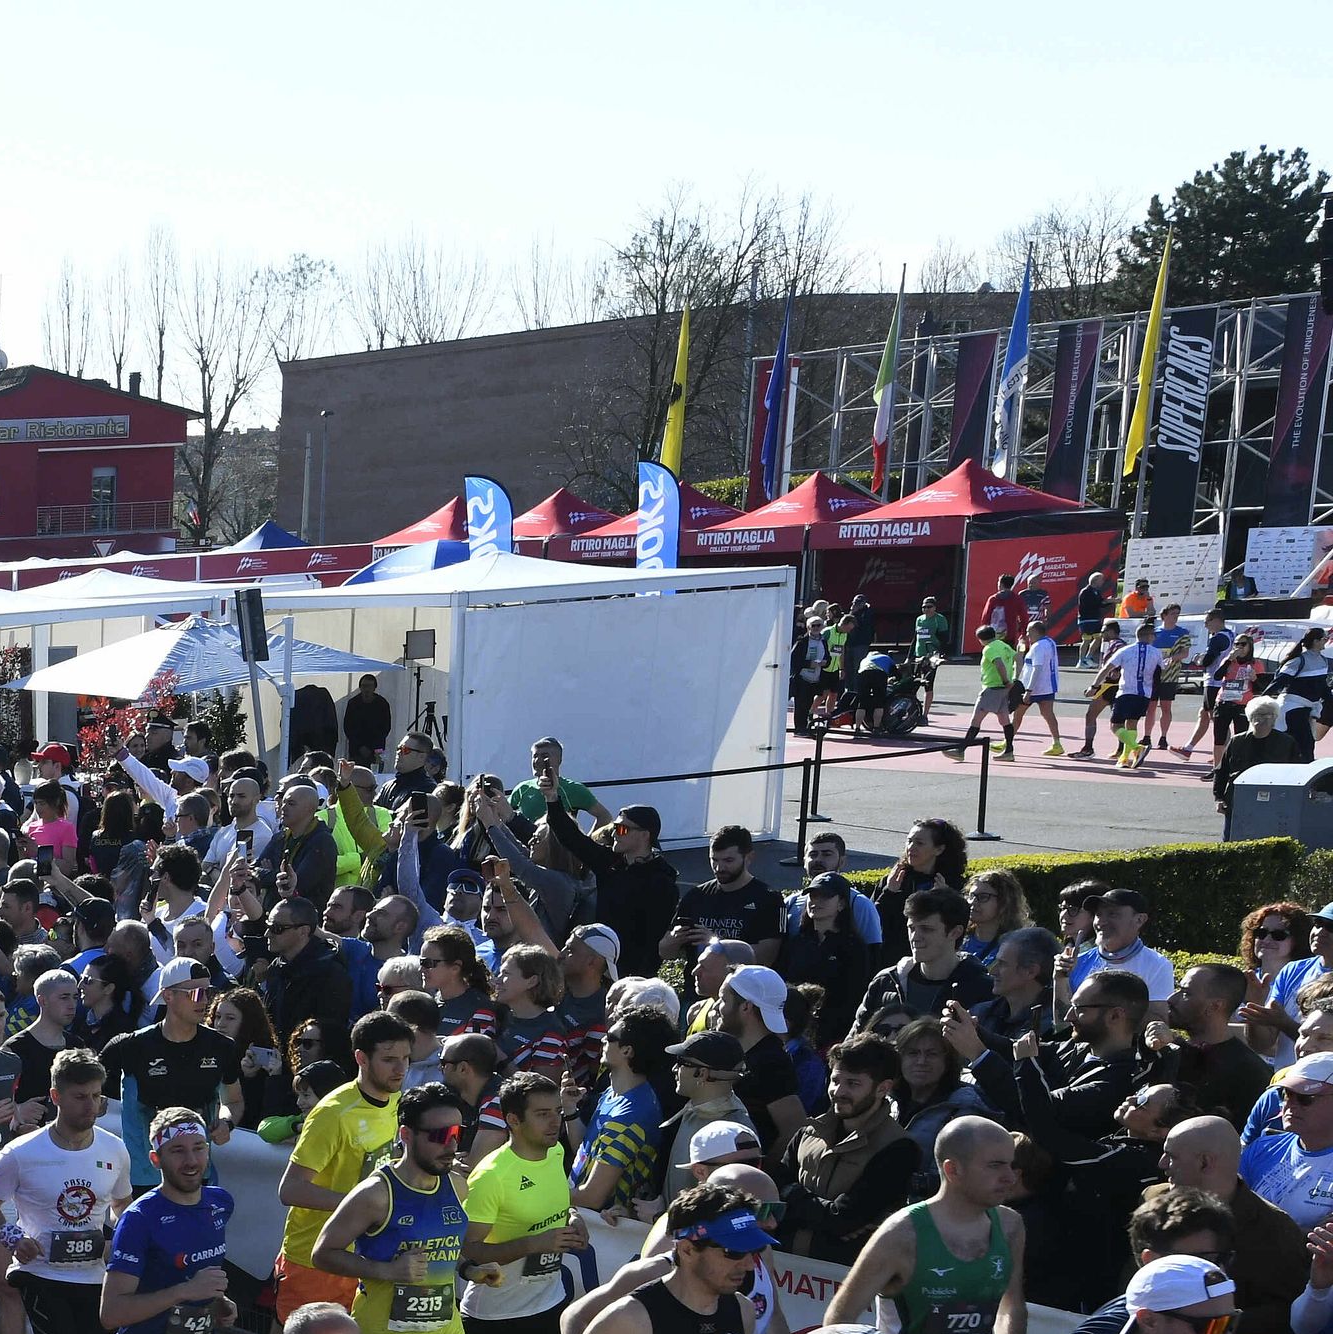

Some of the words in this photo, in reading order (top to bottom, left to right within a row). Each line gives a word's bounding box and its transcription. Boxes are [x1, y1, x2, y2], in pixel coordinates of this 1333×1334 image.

[1301, 357, 1308, 371] OF
[1156, 325, 1213, 463] SUPERCARS
[1294, 371, 1308, 428] EVOLUTION
[1064, 378, 1078, 445] L'EVOLUZIONE
[26, 419, 126, 438] Ristorante
[1292, 430, 1301, 448] THE
[697, 530, 731, 546] RITIRO
[733, 528, 776, 544] MAGLIA
[839, 523, 880, 538] RITIRO
[881, 521, 931, 537] MAGLIA
[571, 539, 602, 552] RITIRO
[1044, 562, 1078, 570] MARATONA
[698, 916, 744, 930] RUNNERS
[63, 1179, 92, 1190] PASSO
[65, 1238, 93, 1253] 386
[398, 1236, 461, 1252] ATLETICA
[406, 1297, 443, 1313] 2313
[184, 1316, 213, 1332] 424
[947, 1312, 983, 1330] 770
